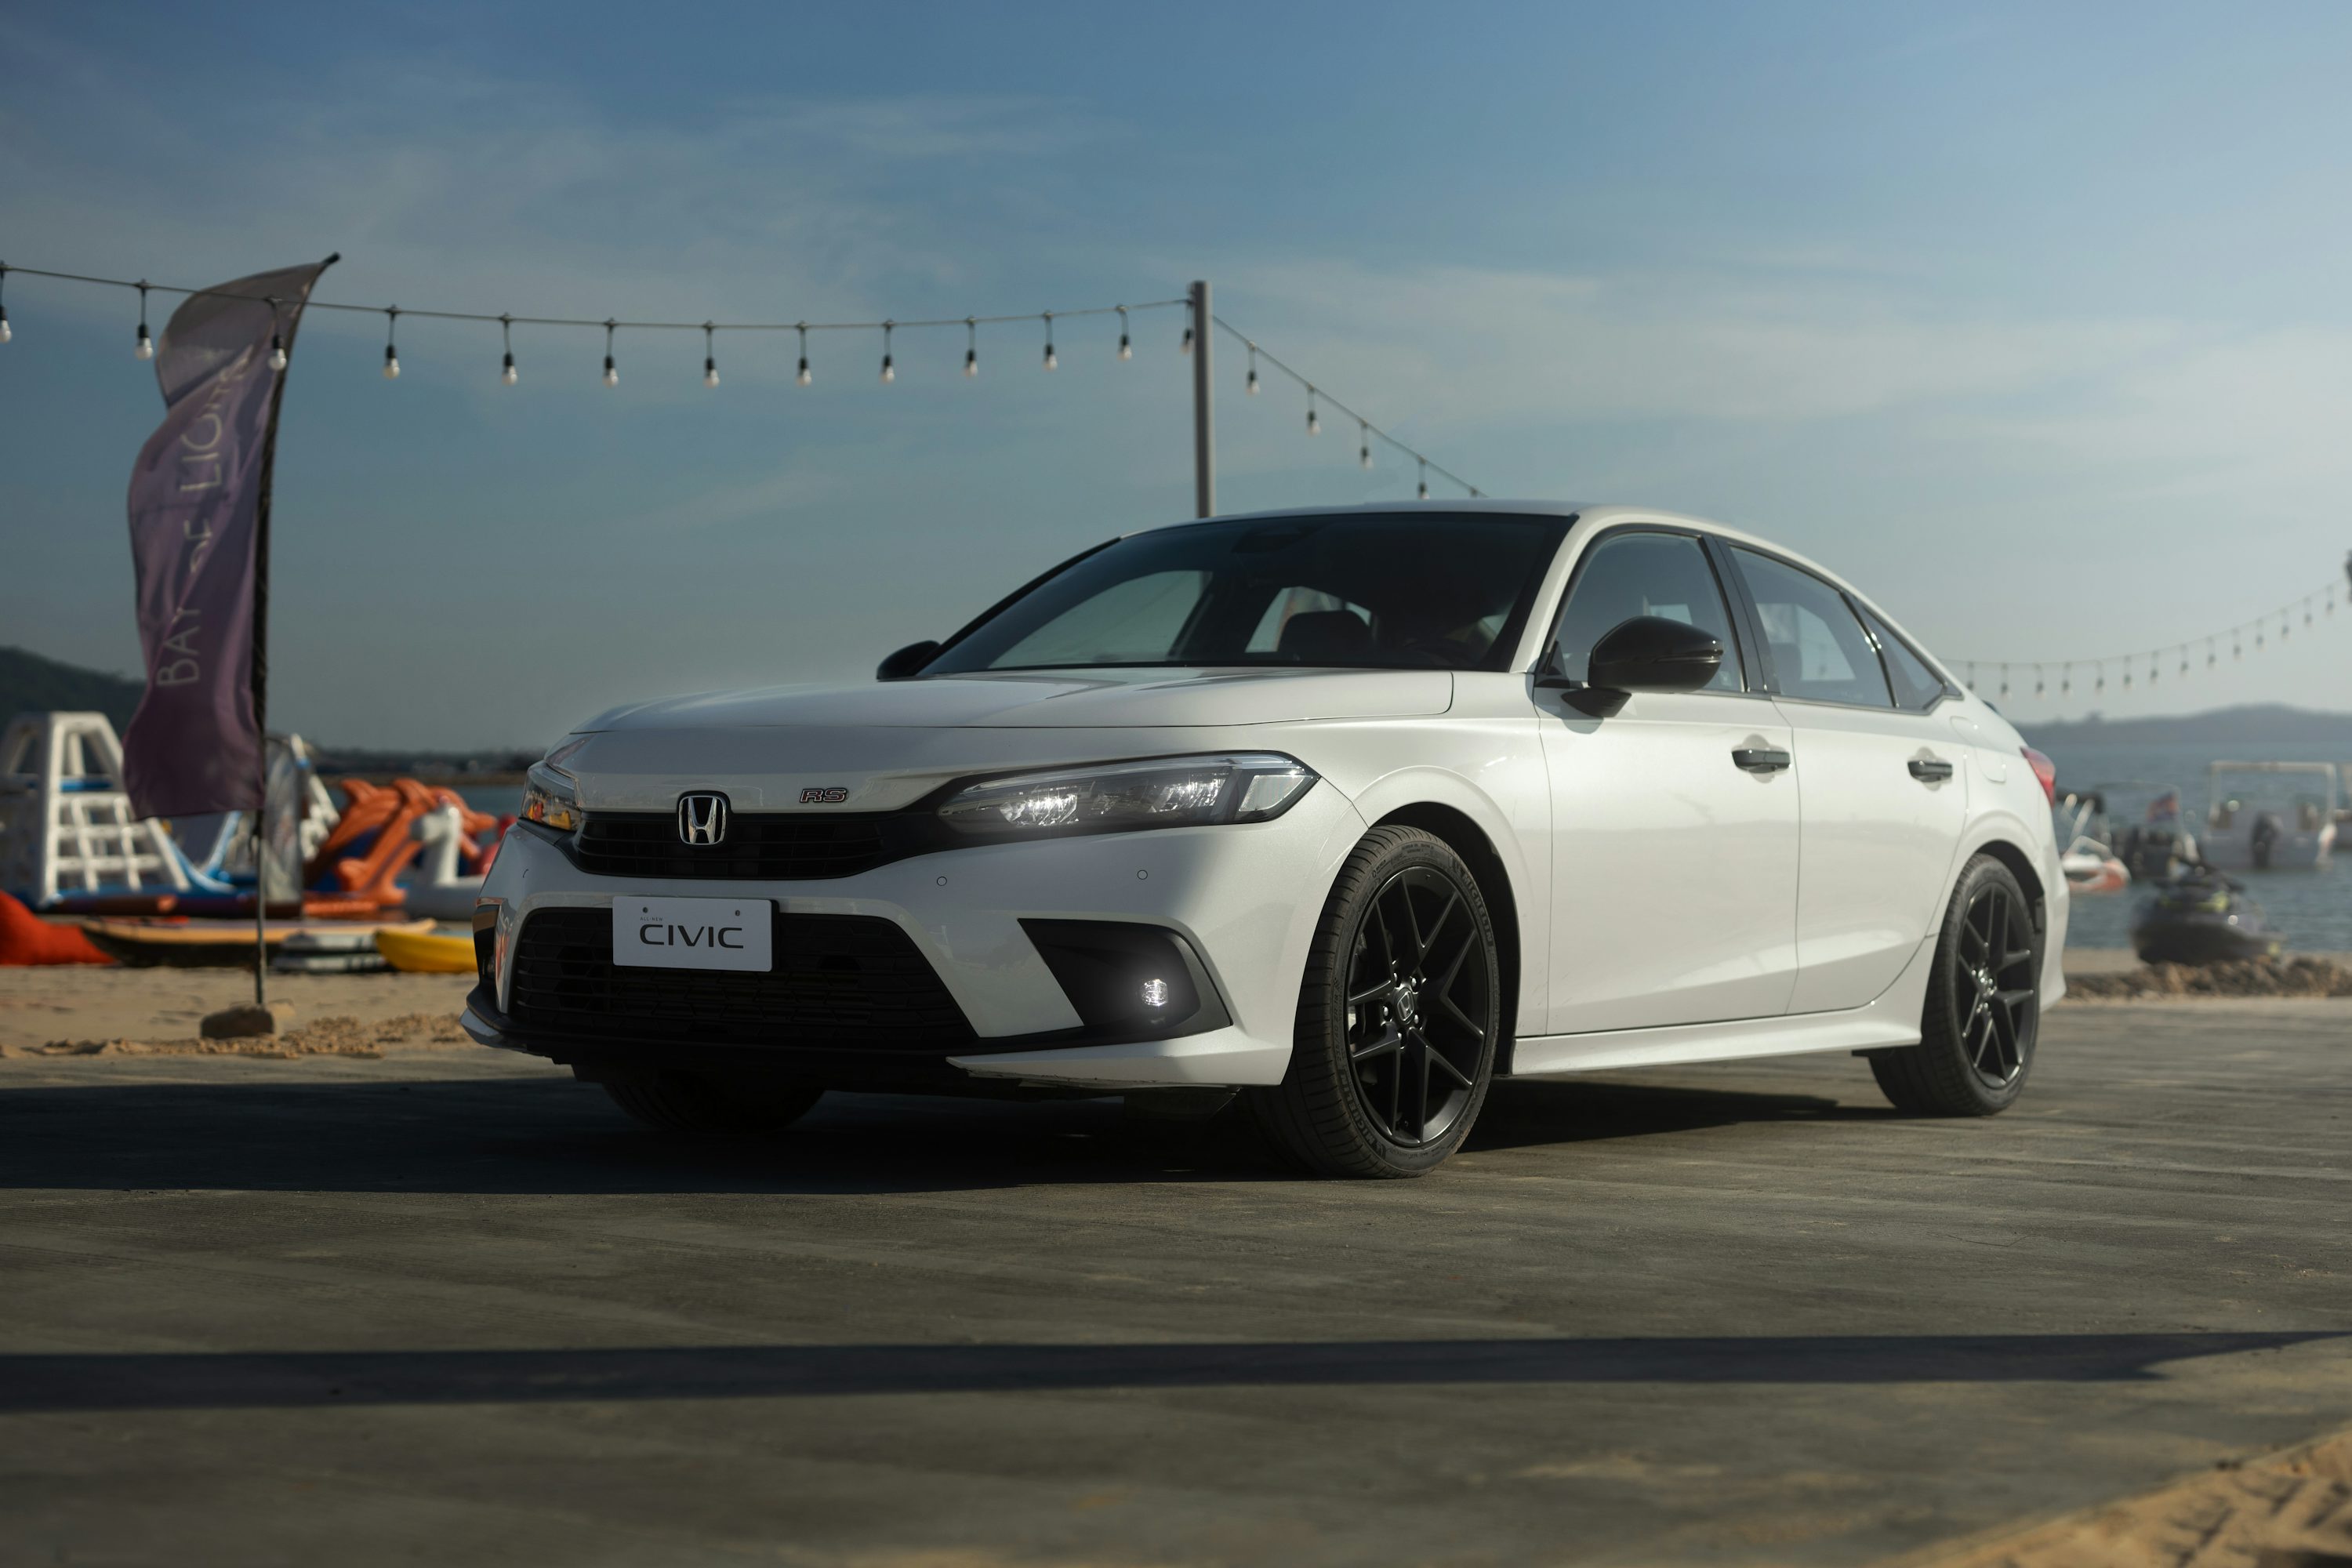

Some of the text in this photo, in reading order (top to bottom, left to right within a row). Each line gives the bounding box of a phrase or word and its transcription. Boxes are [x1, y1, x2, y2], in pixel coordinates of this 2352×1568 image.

[157, 607, 201, 686] BAY
[800, 788, 848, 803] RS
[640, 924, 744, 949] CIVIC
